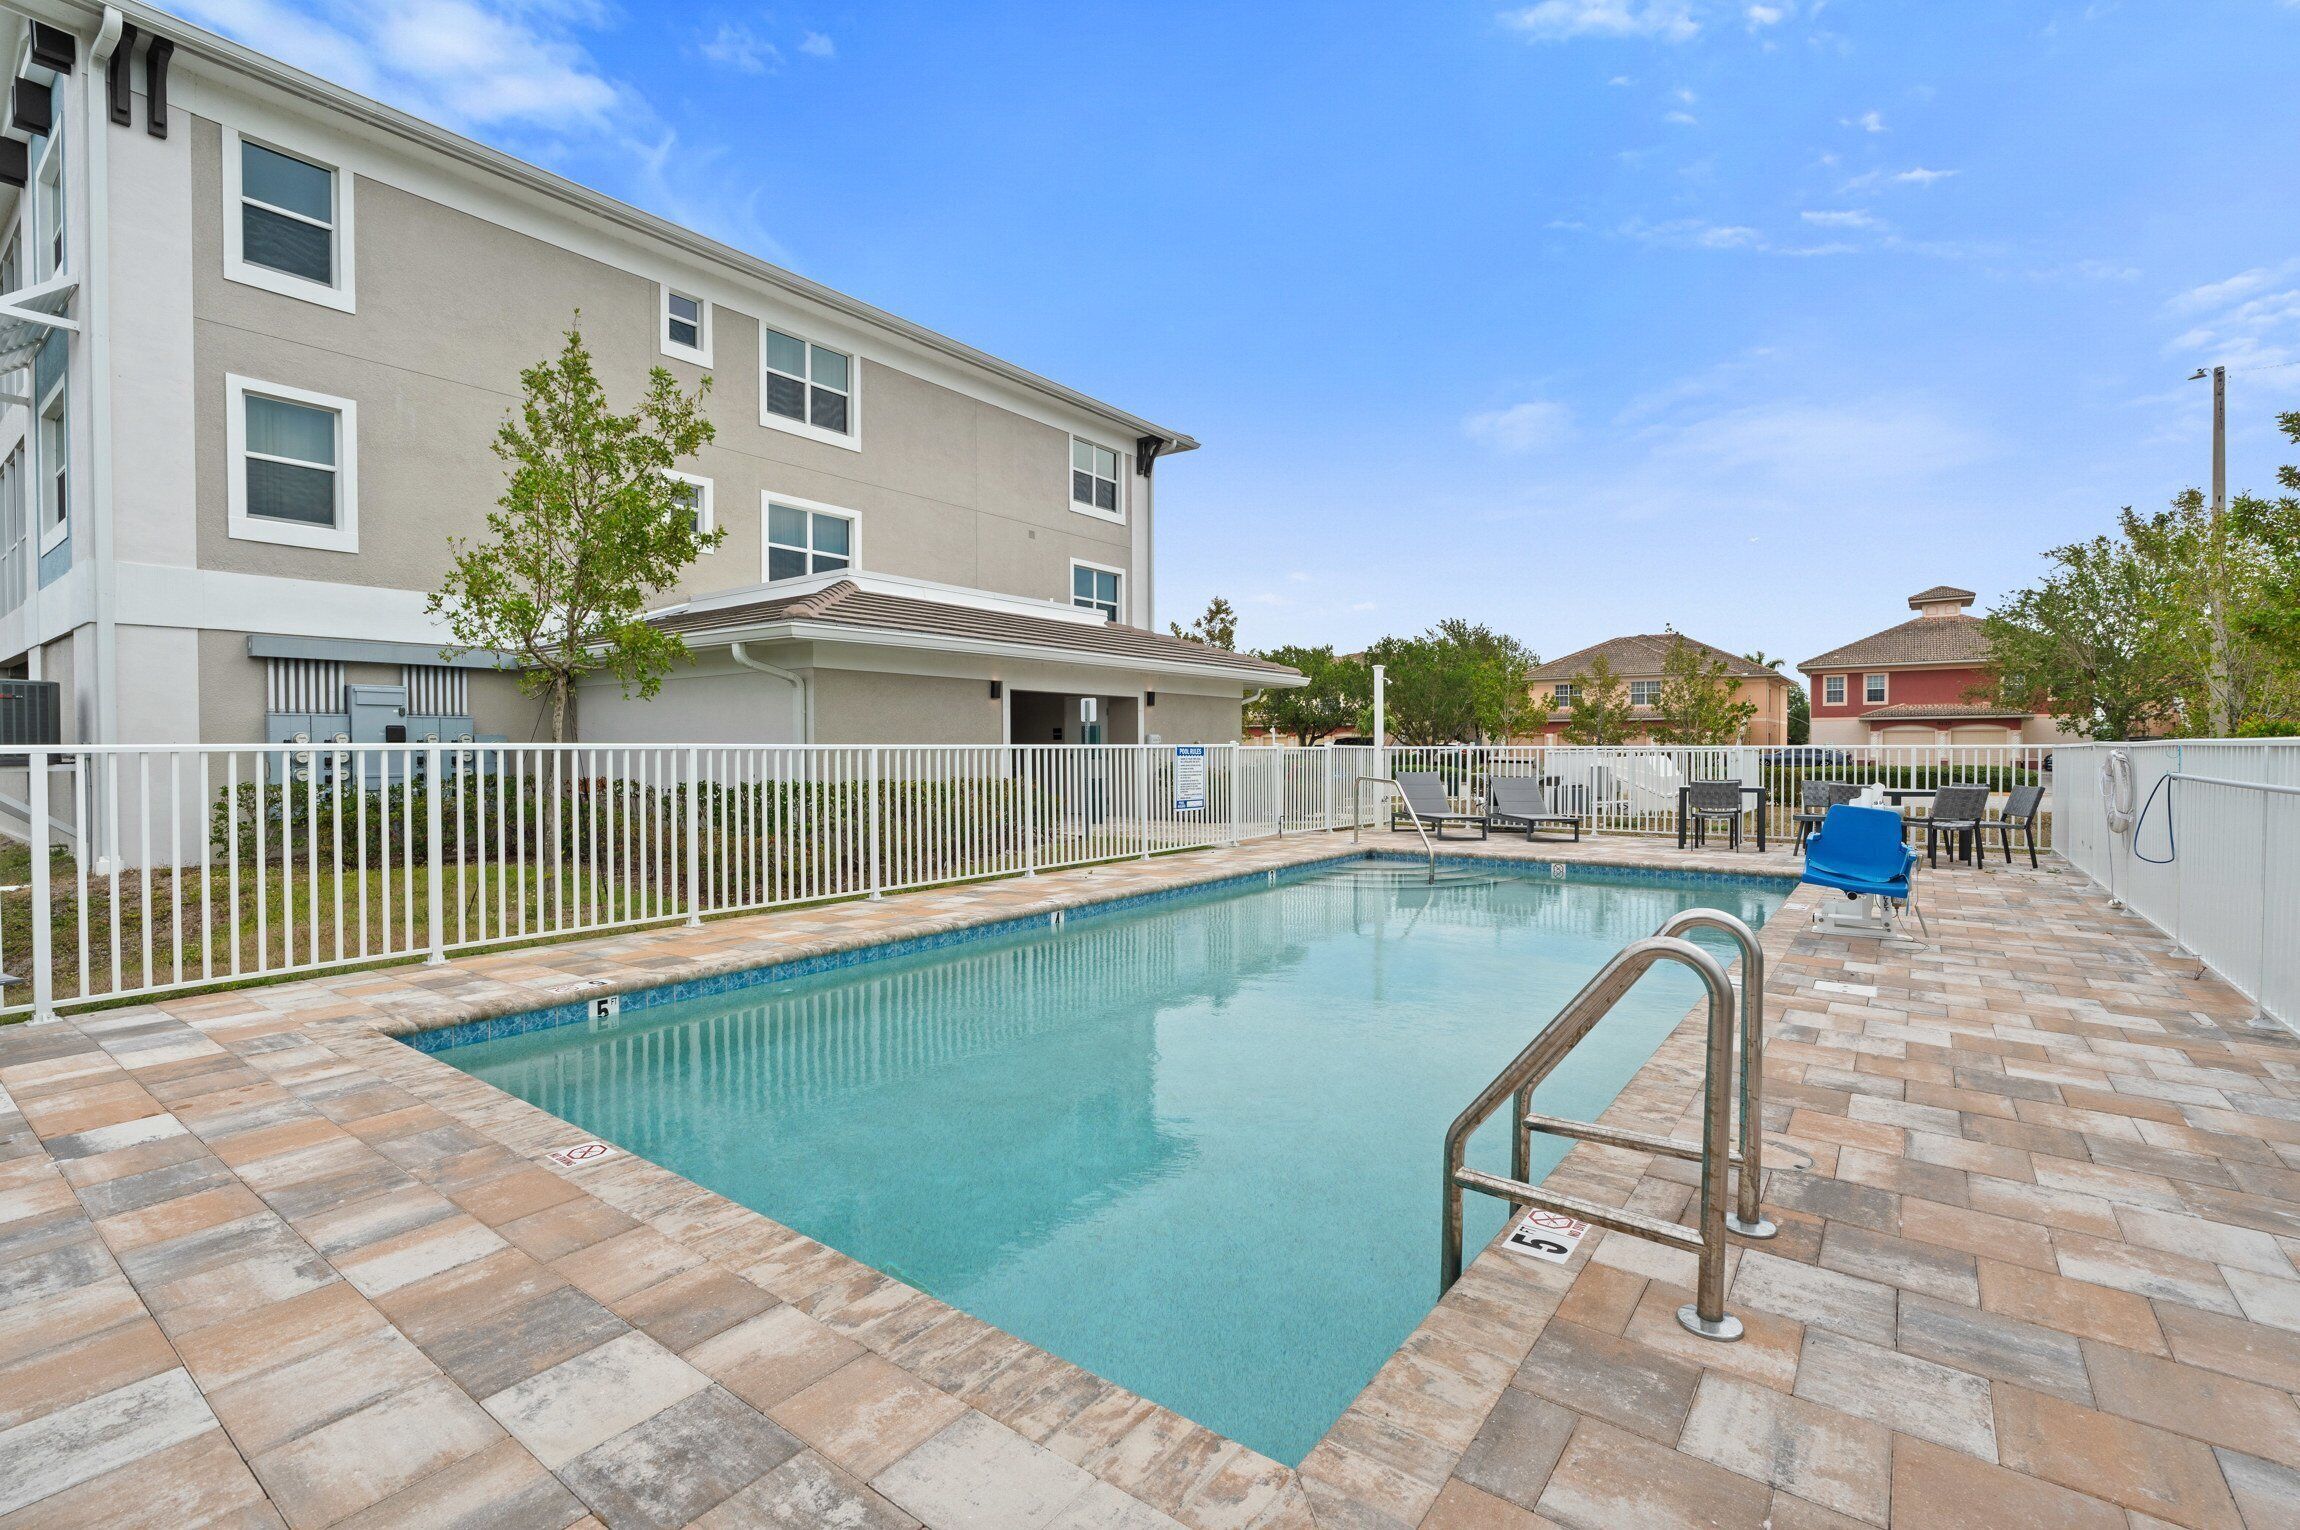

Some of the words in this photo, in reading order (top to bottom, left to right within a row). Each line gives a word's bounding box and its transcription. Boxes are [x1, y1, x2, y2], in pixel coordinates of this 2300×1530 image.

[597, 999, 609, 1017] 5
[611, 996, 618, 1005] FT
[1510, 1233, 1568, 1255] 5
